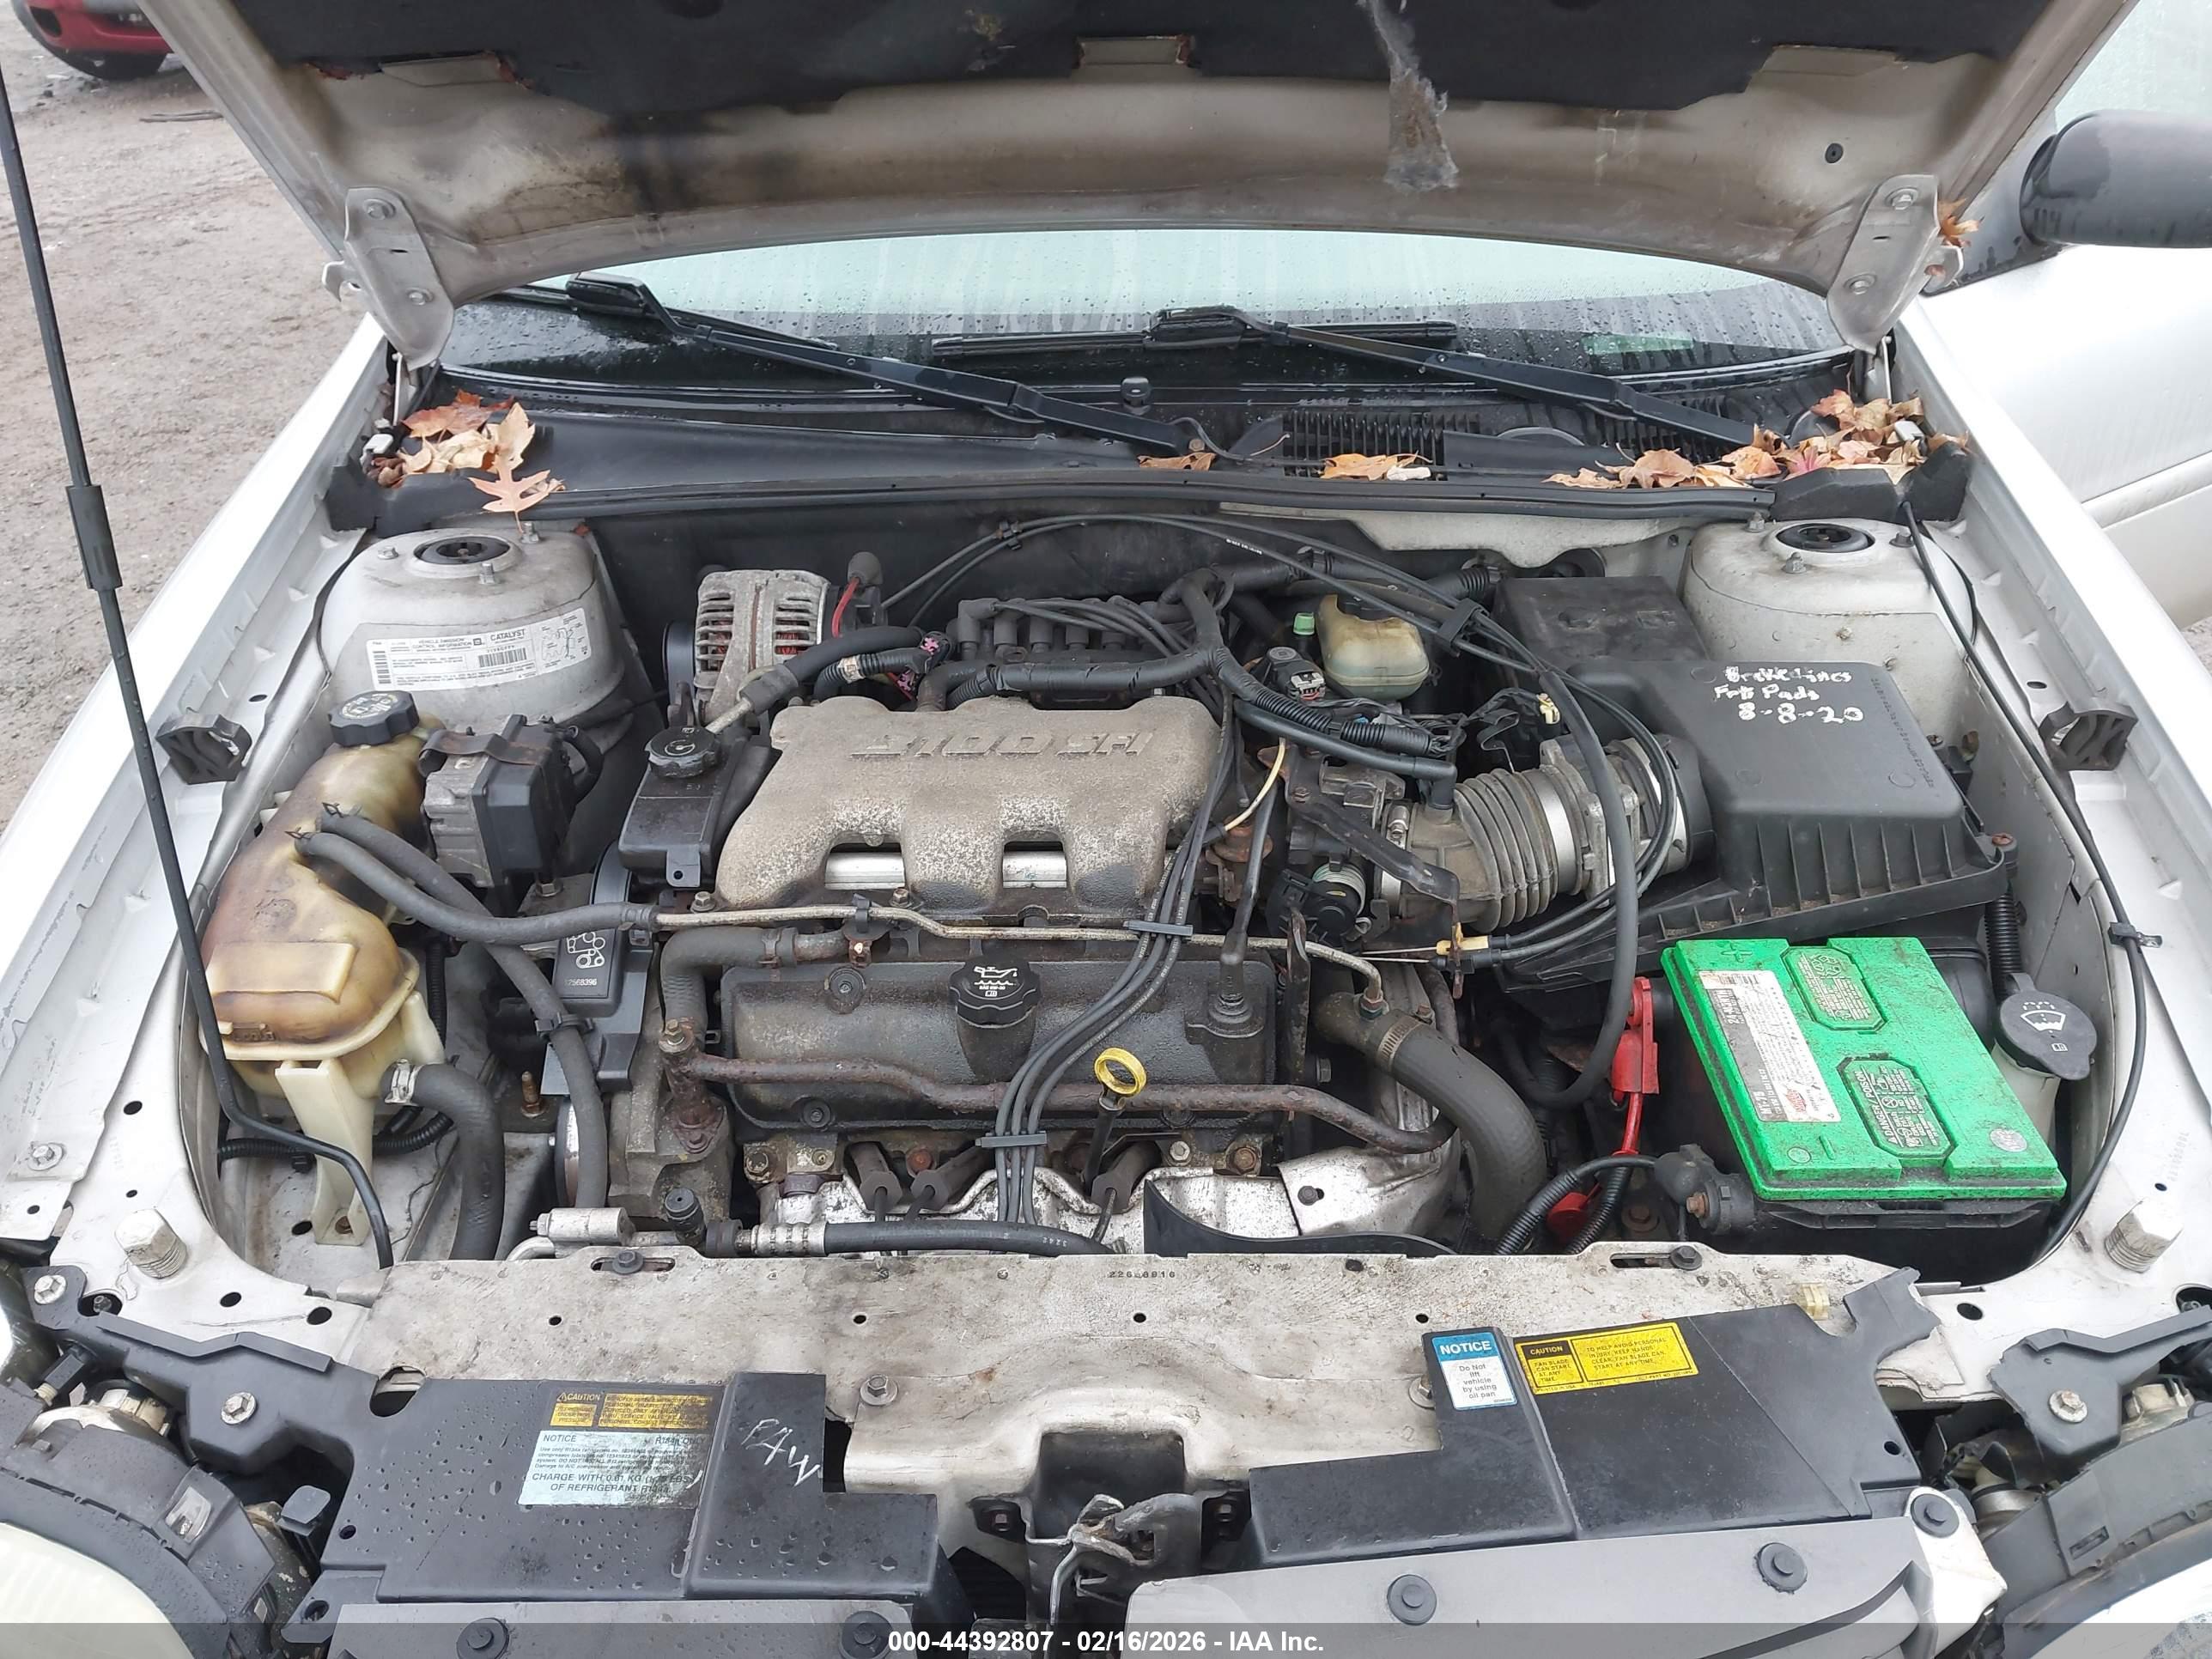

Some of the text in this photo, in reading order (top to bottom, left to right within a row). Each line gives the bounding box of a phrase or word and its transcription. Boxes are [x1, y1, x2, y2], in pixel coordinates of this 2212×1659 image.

[490, 629, 526, 641] CATALYST
[1855, 1071, 1875, 1098] POISON
[1872, 1104, 1894, 1137] DANGER
[1633, 1337, 1668, 1346] PERSONAL
[1440, 1340, 1492, 1355] NOTICE
[1530, 1346, 1563, 1355] CAUTION
[1474, 1383, 1498, 1392] using
[568, 1393, 601, 1402] CAUTION
[532, 1473, 574, 1481] CHARGE
[578, 1474, 602, 1482] WITH
[550, 1483, 564, 1492] OF
[567, 1484, 638, 1492] REFRIGERANT
